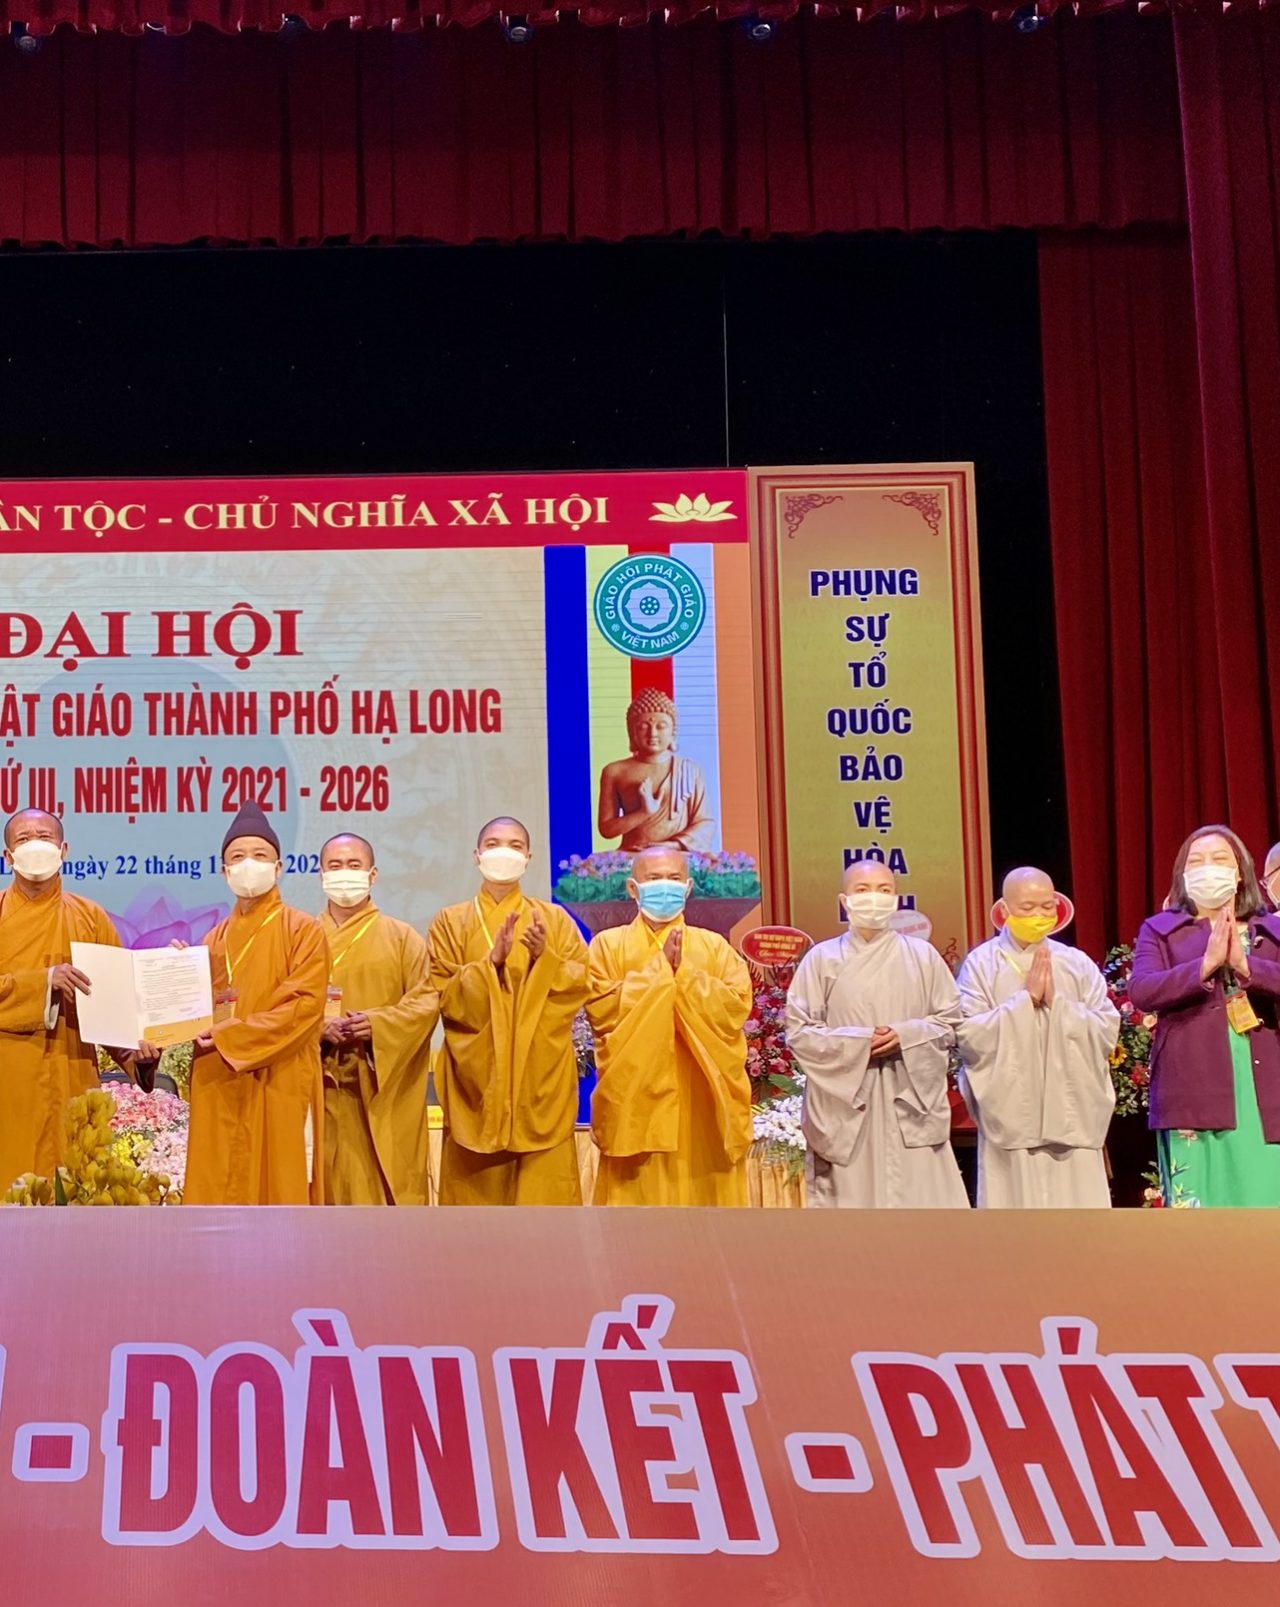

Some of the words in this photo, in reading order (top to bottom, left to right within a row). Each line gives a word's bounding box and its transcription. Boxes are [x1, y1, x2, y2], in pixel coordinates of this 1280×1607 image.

[54, 500, 147, 538] TỘC
[183, 494, 279, 530] CHỦ
[291, 494, 437, 529] NGHĨA
[448, 492, 511, 527] XÃ
[523, 493, 609, 531] HỘI
[603, 585, 618, 620] GIÁO
[616, 565, 640, 584] HỘI
[644, 563, 682, 582] PHẬT
[680, 583, 697, 618] GIÁO
[810, 569, 919, 601] PHỤNG
[151, 602, 303, 670] HỘI
[621, 630, 649, 649] VIỆT
[650, 630, 680, 649] NAM
[846, 613, 890, 647] SỰ
[848, 651, 887, 688] TỔ
[52, 683, 132, 737] GIÁO
[143, 682, 257, 736] THÀNH
[271, 674, 340, 735] PHỐ
[351, 690, 399, 744] HẠ
[409, 688, 502, 734] LONG
[827, 699, 912, 738] QUỐC
[840, 746, 903, 781] BẢO
[28, 767, 64, 819] III,
[74, 757, 167, 824] NHIỆM
[177, 756, 213, 813] KỲ
[222, 766, 287, 812] 2021
[320, 765, 390, 812] 2026
[854, 796, 892, 833] VỆ
[62, 855, 109, 881] ngày
[116, 855, 138, 874] 22
[145, 854, 202, 880] tháng
[117, 1318, 483, 1538] ĐOÀN
[508, 1304, 762, 1543] KẾT
[867, 1326, 1264, 1549] PHÁT
